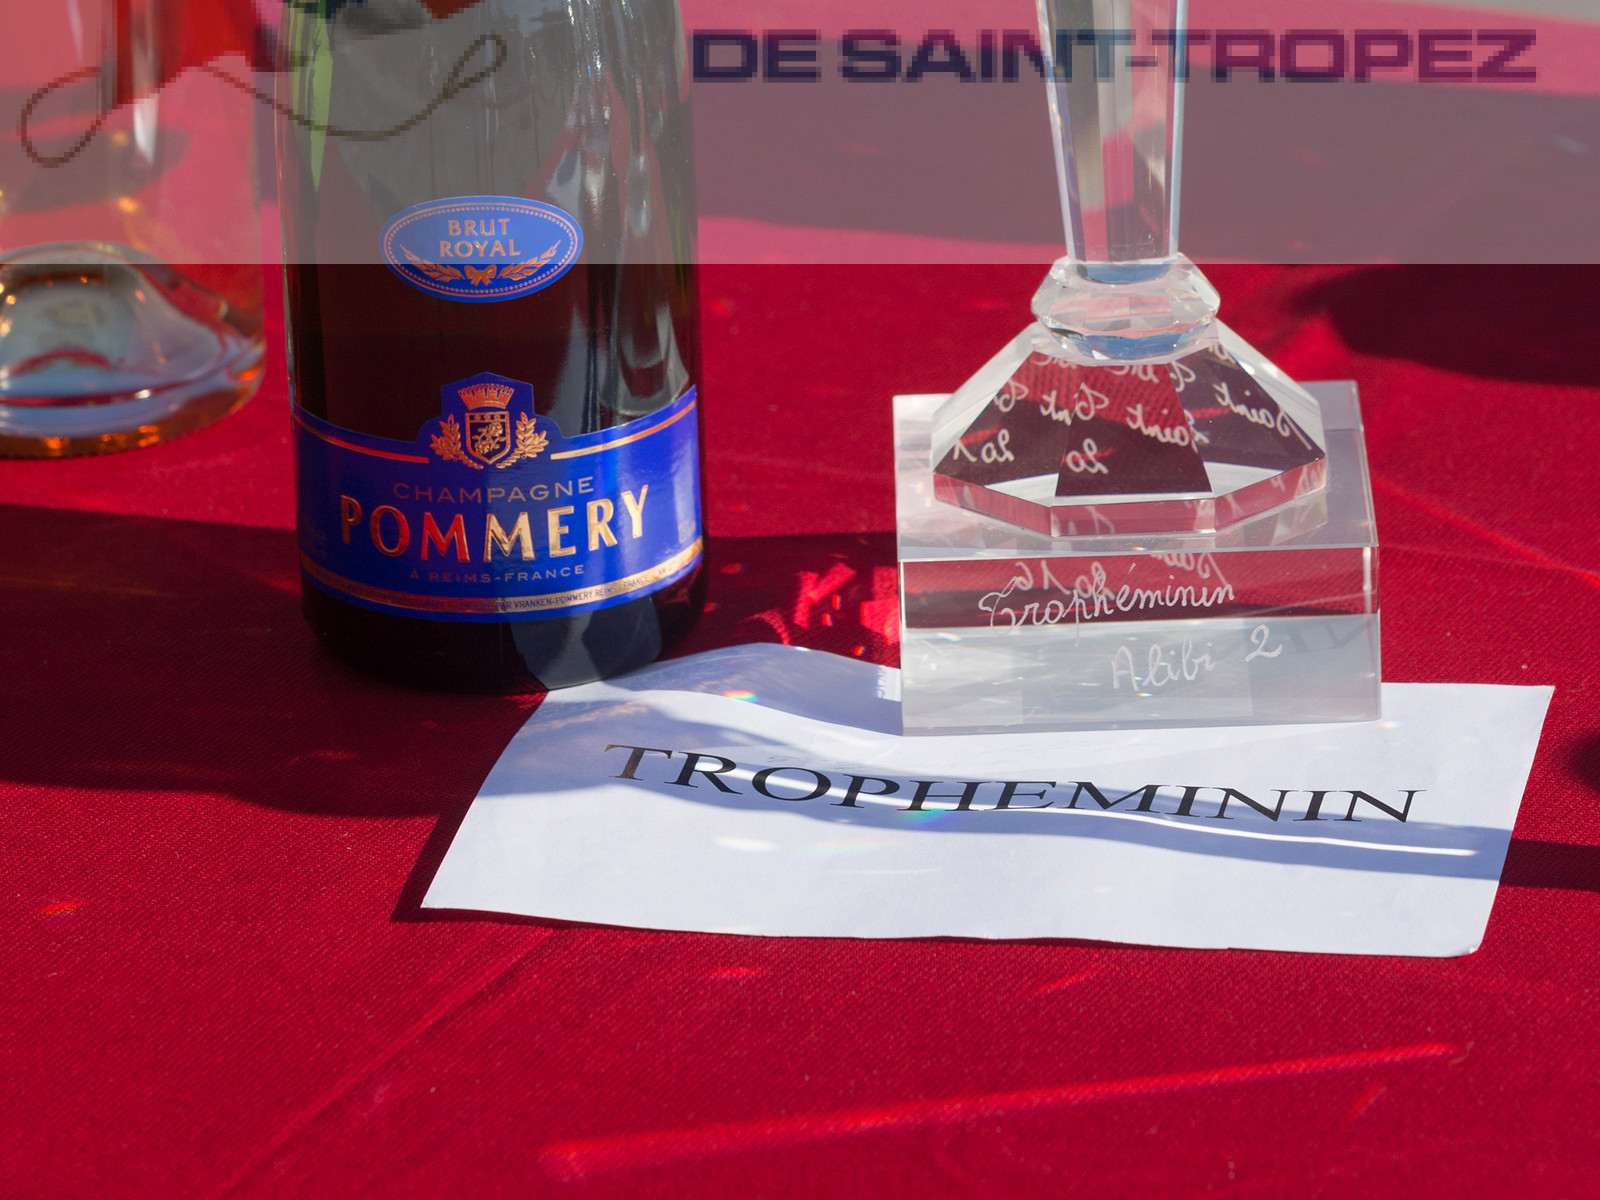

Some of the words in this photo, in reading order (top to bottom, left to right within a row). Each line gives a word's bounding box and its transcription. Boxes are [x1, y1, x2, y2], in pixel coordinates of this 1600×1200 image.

[439, 239, 521, 258] ROYAL
[447, 218, 510, 236] BRUT
[393, 476, 595, 503] CHAMPAGNE
[340, 484, 649, 563] POMMERY
[1111, 632, 1218, 692] Alibi
[1244, 624, 1283, 662] 2
[604, 743, 1429, 824] TROPHEMININ
